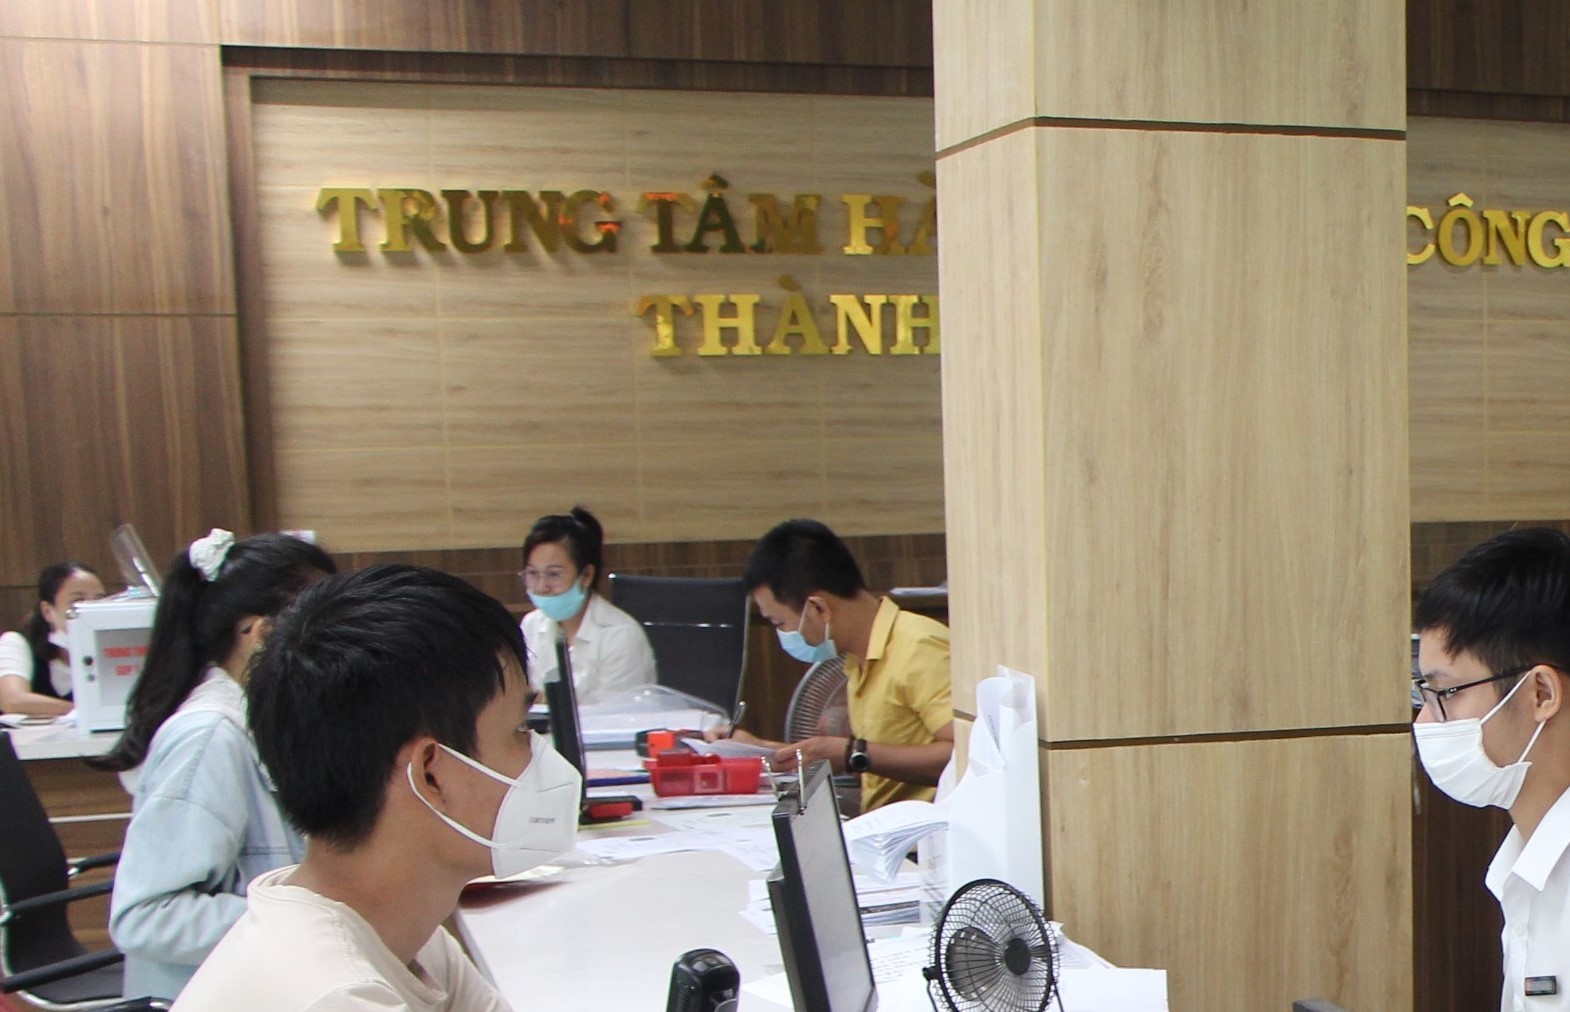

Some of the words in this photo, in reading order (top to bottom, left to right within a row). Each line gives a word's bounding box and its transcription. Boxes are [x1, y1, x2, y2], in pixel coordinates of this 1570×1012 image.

[315, 187, 622, 254] TRUNG
[636, 173, 823, 254] TÂM
[635, 274, 941, 357] THÀNH
